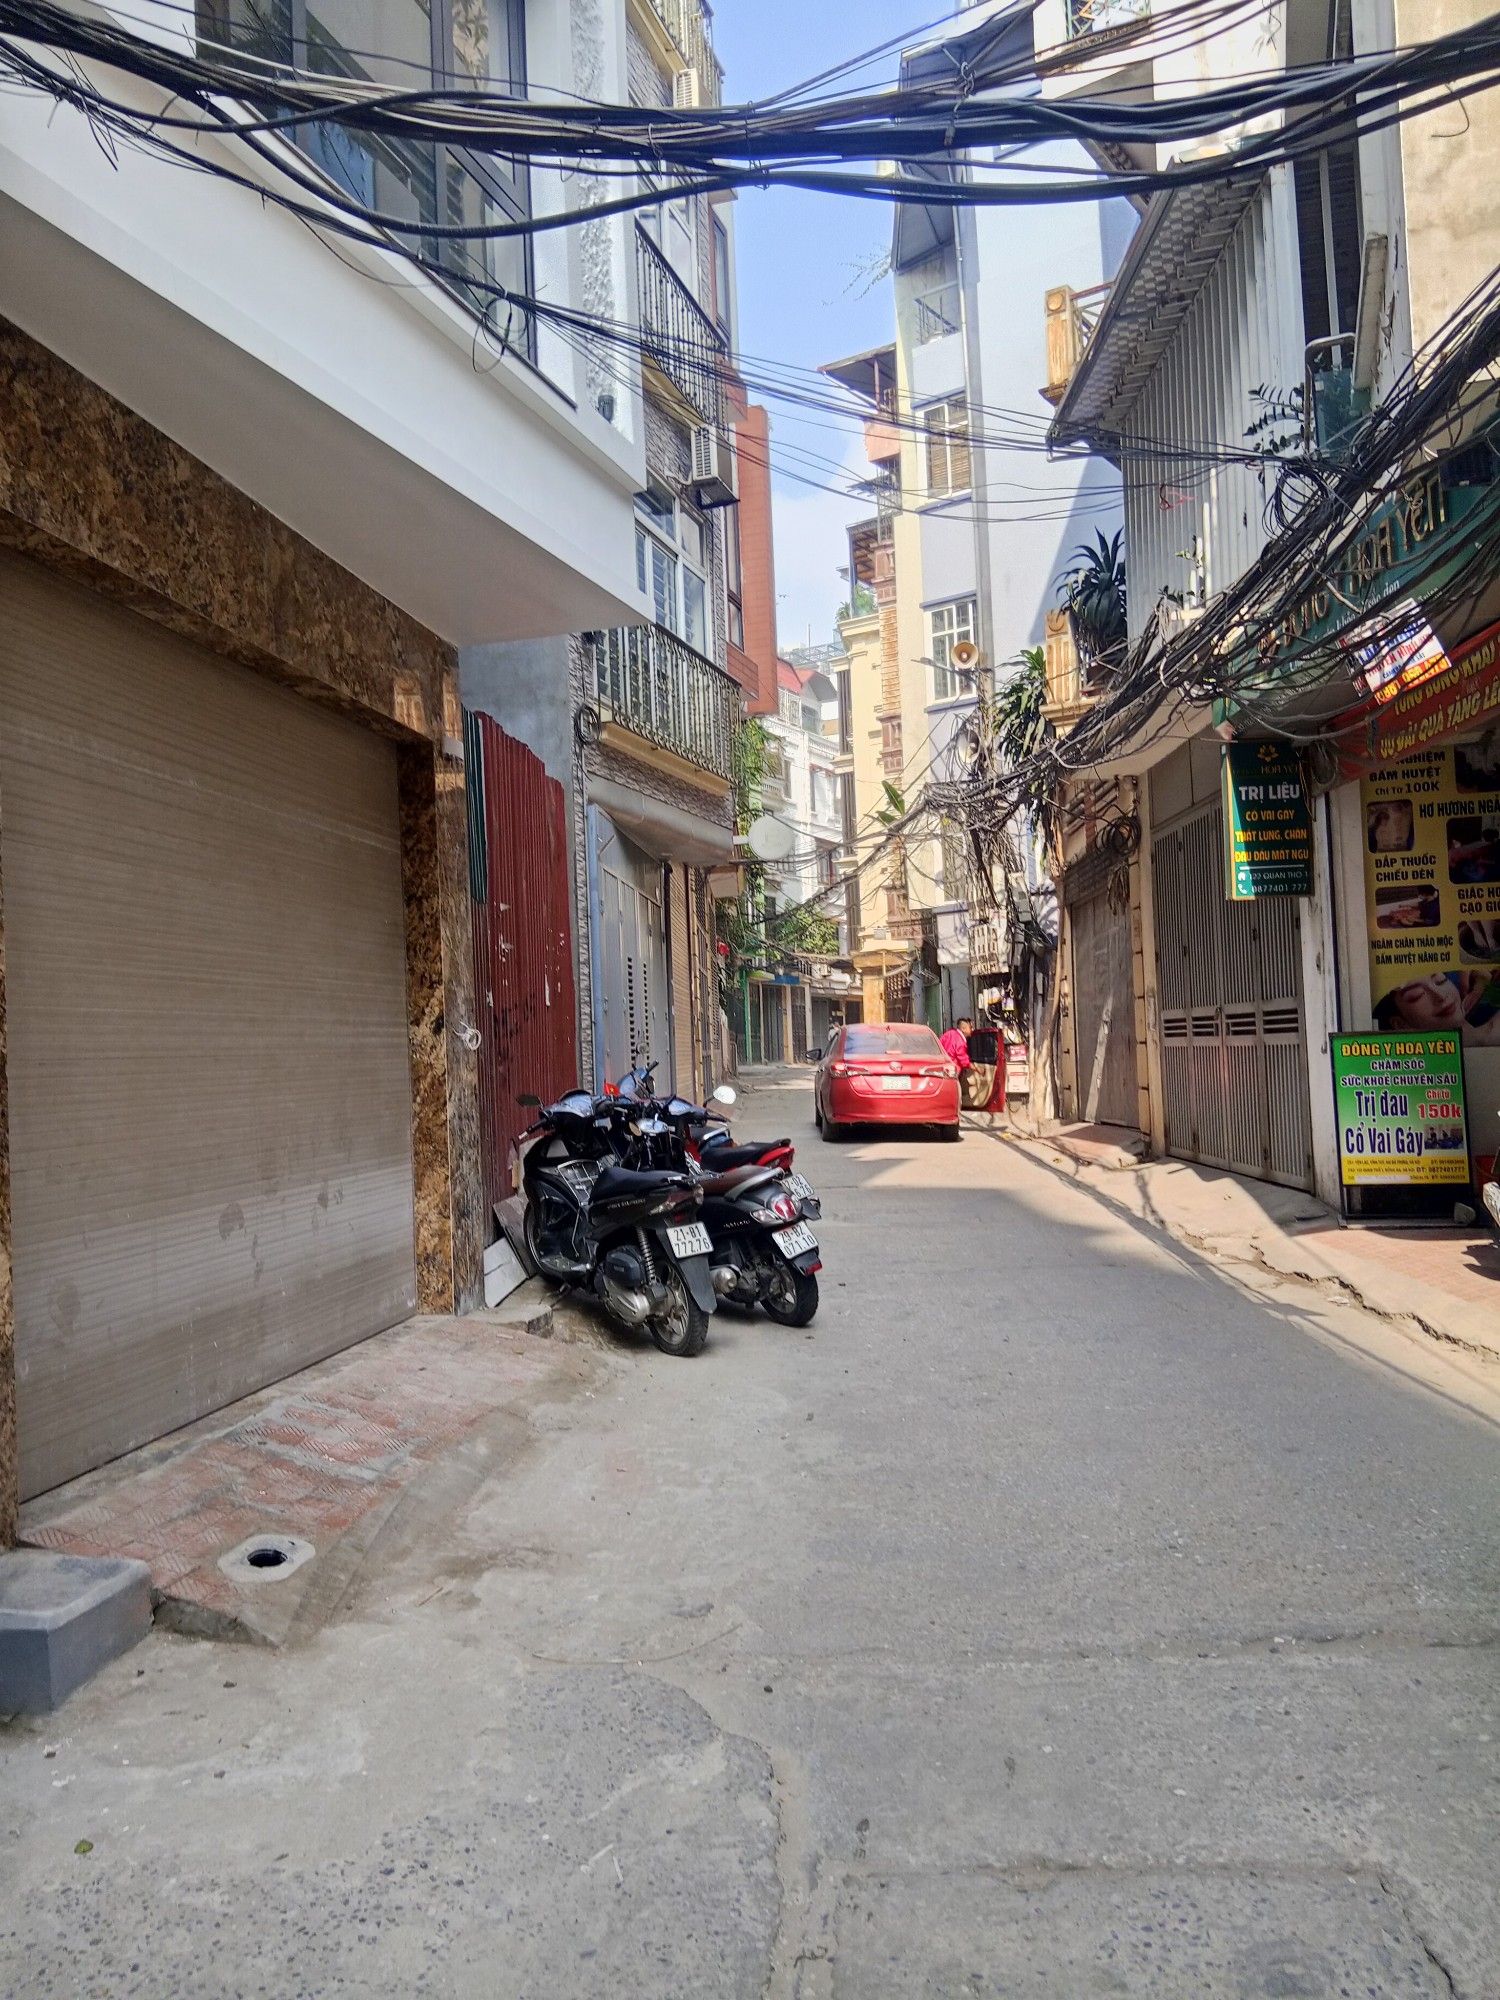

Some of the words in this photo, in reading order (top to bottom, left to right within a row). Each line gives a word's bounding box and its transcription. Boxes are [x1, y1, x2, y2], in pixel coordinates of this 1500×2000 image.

[1447, 692, 1480, 731] TẶNG
[1401, 766, 1441, 779] HUYỆT
[1239, 785, 1264, 804] TRỊ
[1268, 781, 1300, 803] LIỆU
[1405, 780, 1440, 793] 100K
[1260, 809, 1275, 821] VAI
[1400, 852, 1437, 867] THUỐC
[1376, 868, 1409, 882] CHIẾU
[1411, 867, 1435, 880] ĐÈN
[1458, 886, 1485, 899] GIÁC
[1460, 901, 1483, 915] CẠO
[1436, 935, 1454, 948] MỘC
[1394, 952, 1417, 965] HUYỆT
[1341, 1040, 1381, 1056] ĐÔNG
[1384, 1042, 1392, 1055] Y
[1396, 1042, 1424, 1055] HOA
[1427, 1039, 1455, 1054] YÊN
[1403, 1058, 1425, 1070] SÓC
[1393, 1073, 1434, 1086] CHUYÊN
[1436, 1073, 1458, 1085] SÂU
[1355, 1090, 1376, 1123] Trị
[1380, 1090, 1409, 1117] đau
[1418, 1103, 1461, 1119] 150k
[1345, 1121, 1365, 1154] Cổ
[1367, 1127, 1392, 1154] Vai
[1395, 1126, 1424, 1157] Gáy
[674, 1237, 711, 1256] 772.76
[783, 1234, 816, 1256] 071.10
